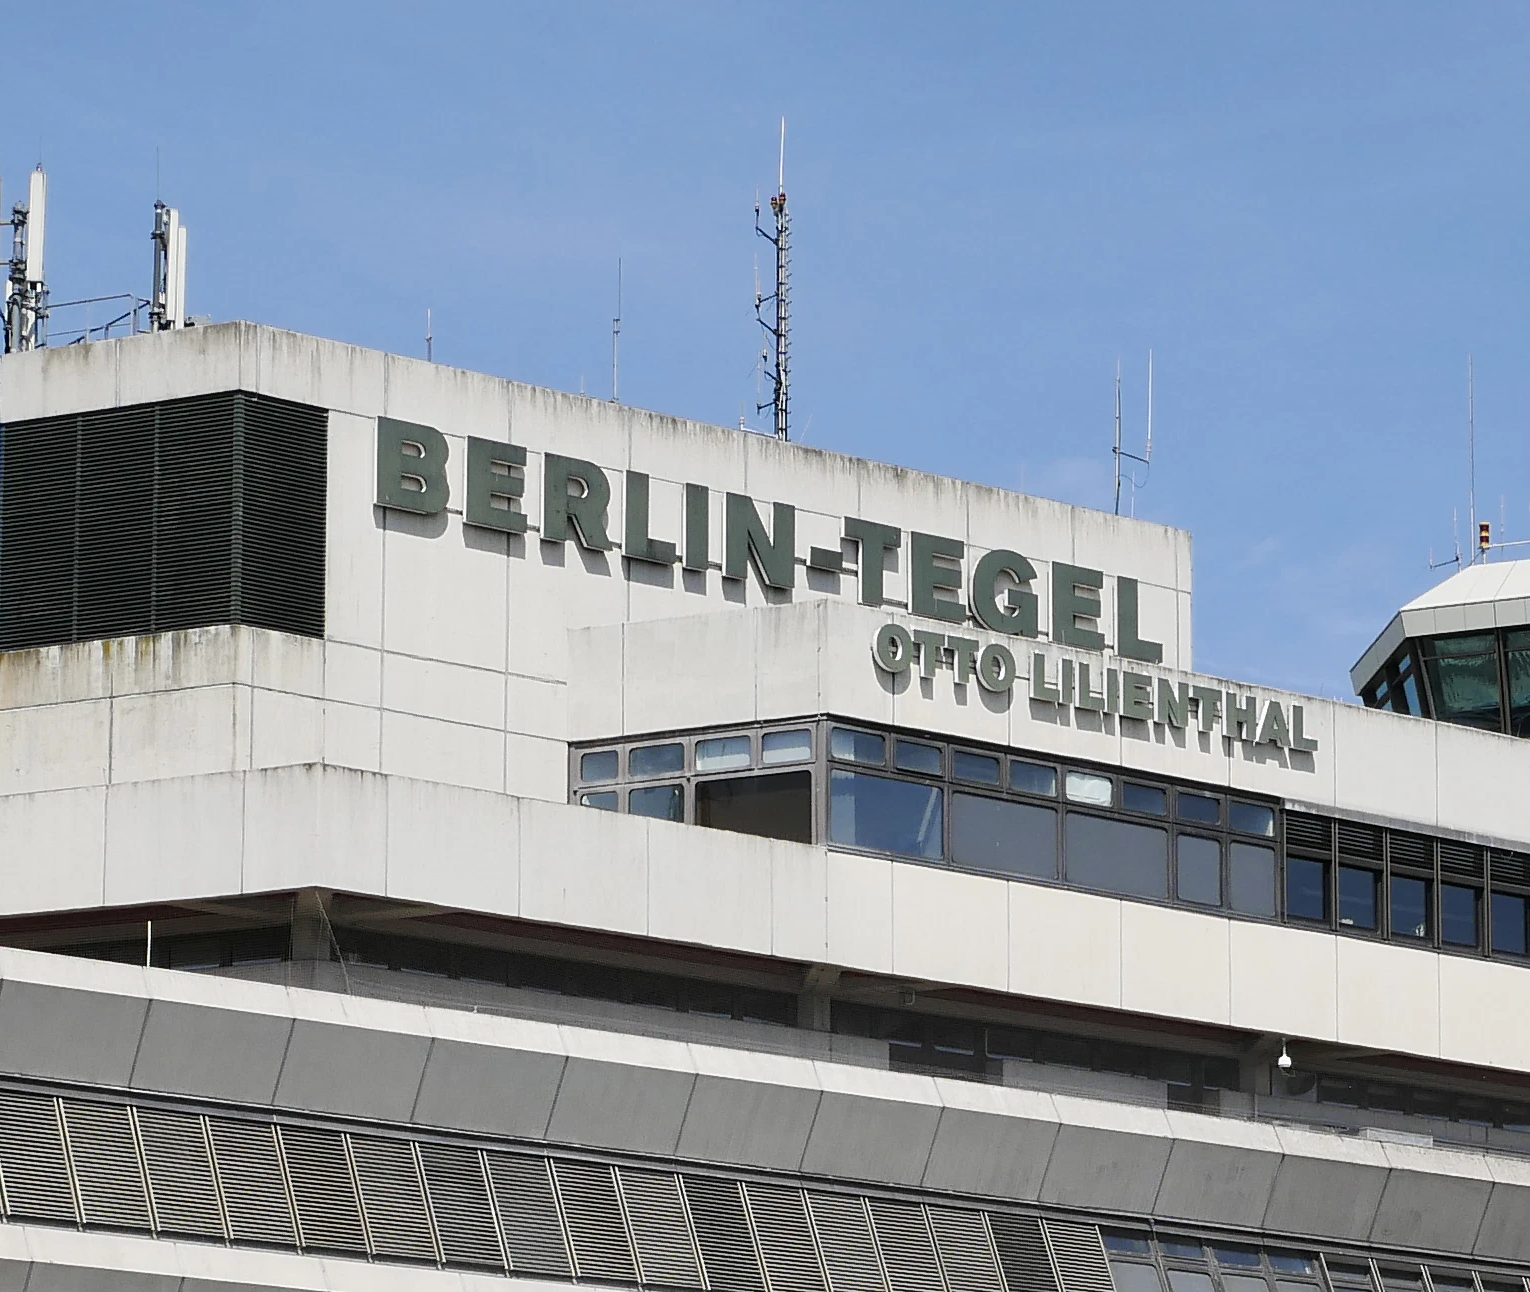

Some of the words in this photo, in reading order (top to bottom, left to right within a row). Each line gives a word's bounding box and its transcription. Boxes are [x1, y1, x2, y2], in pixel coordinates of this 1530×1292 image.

[374, 415, 1163, 663] BERLIN-TEGEL
[872, 624, 1017, 694] OTTO
[1028, 650, 1318, 754] LILIENTHAL
